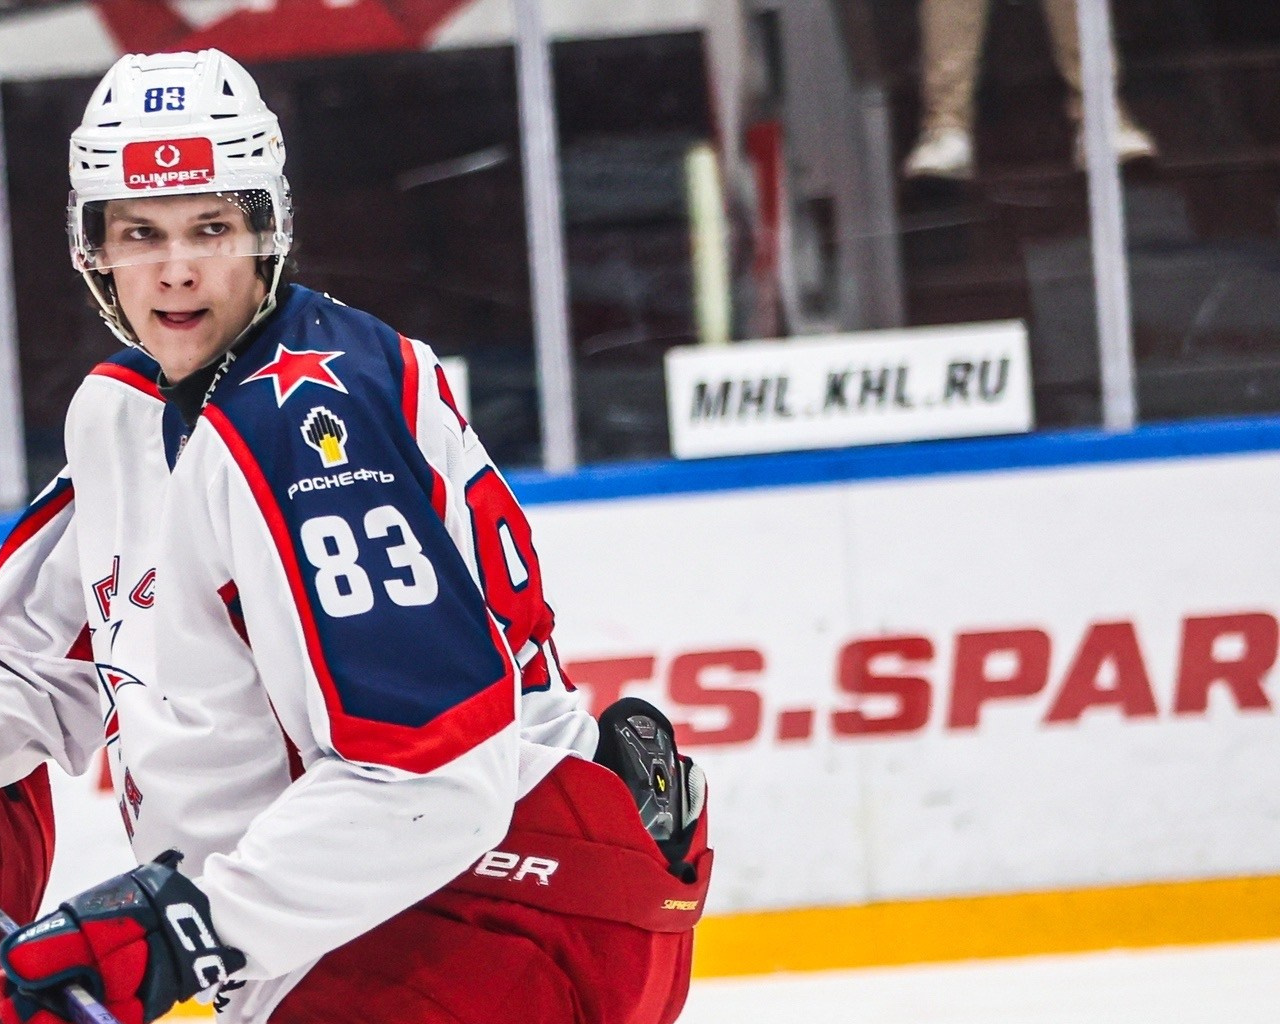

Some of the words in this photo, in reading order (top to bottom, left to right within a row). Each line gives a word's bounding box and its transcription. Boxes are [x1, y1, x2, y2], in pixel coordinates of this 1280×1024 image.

[144, 86, 185, 113] 83
[129, 168, 210, 186] OLIMPBET
[690, 357, 1011, 420] MHL.KHL.RU
[287, 468, 395, 500] РОСНЕФТЬ
[300, 504, 439, 618] 83
